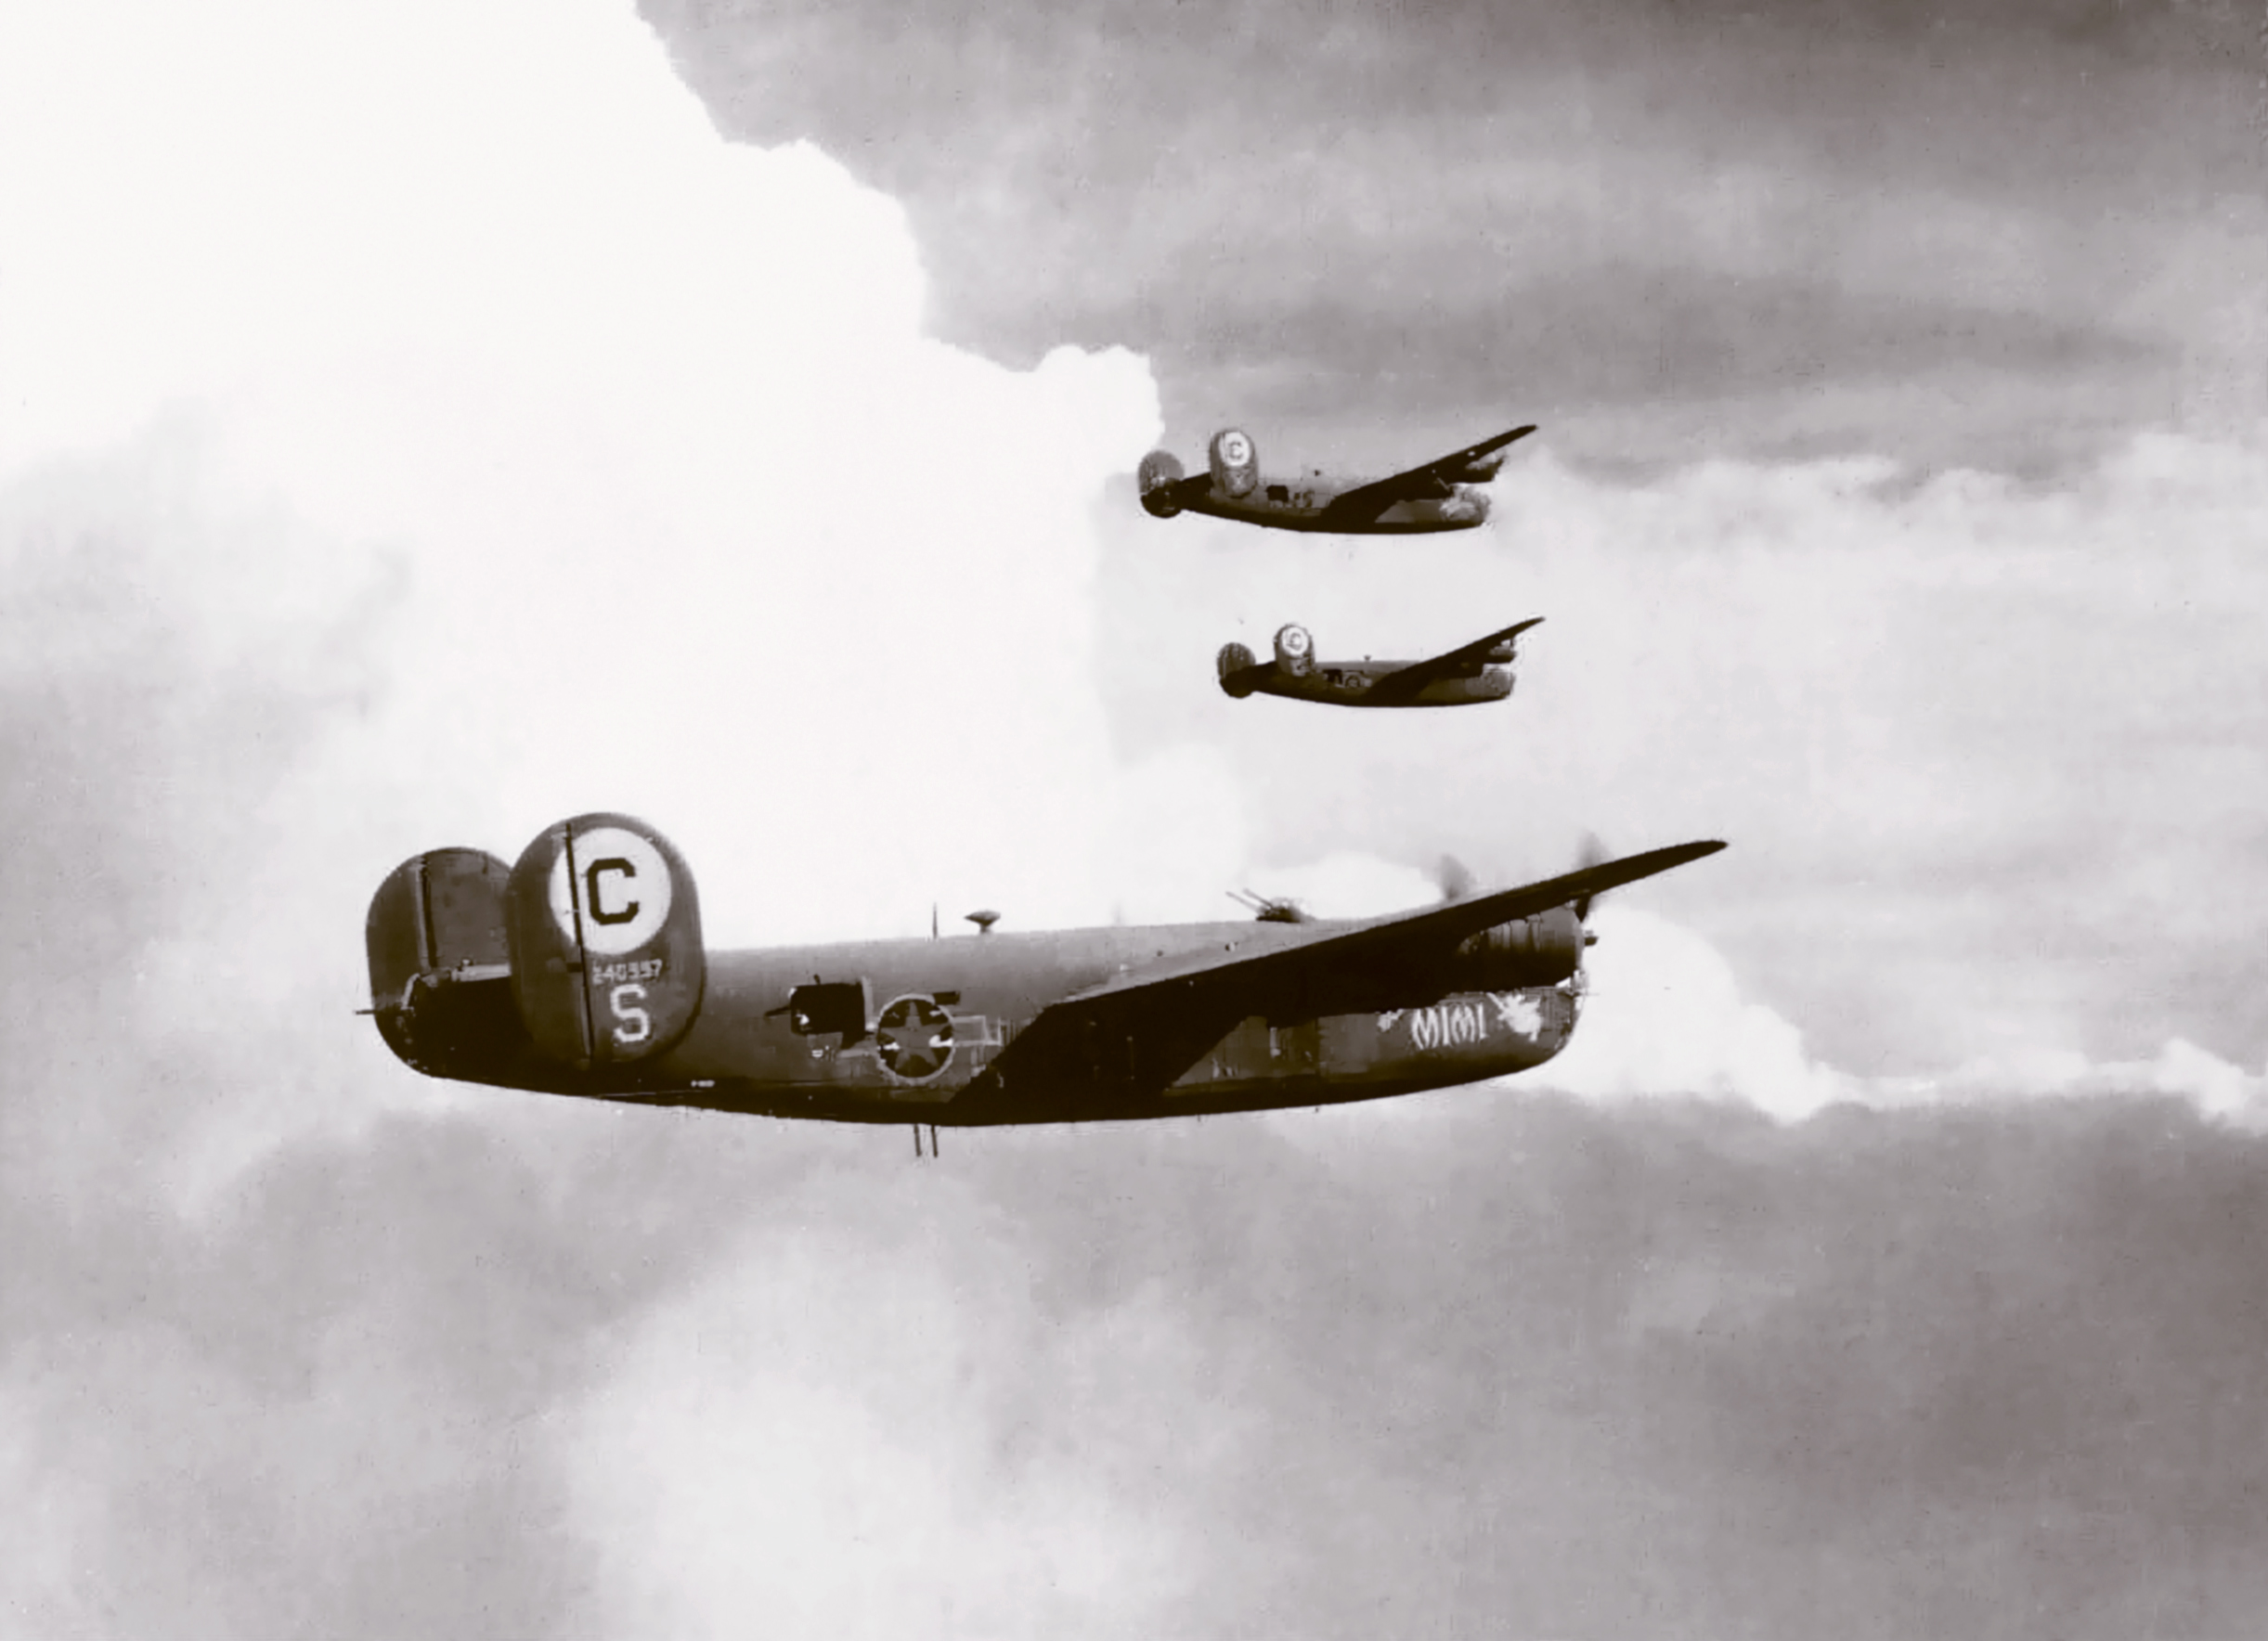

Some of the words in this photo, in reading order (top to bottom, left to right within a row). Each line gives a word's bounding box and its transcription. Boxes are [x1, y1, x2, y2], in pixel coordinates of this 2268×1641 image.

[1228, 440, 1243, 459] C
[587, 858, 640, 926] C
[610, 983, 650, 1043] S
[1411, 1002, 1487, 1050] MIMI
